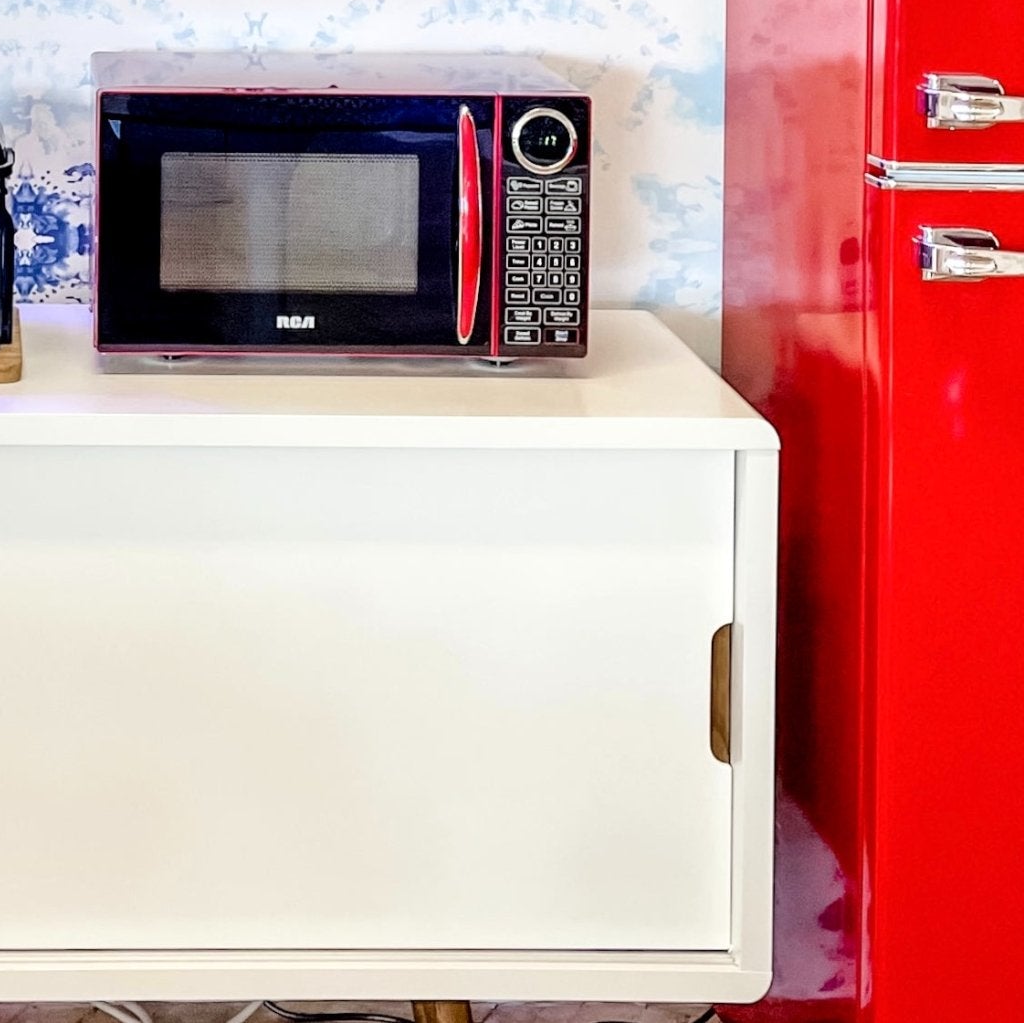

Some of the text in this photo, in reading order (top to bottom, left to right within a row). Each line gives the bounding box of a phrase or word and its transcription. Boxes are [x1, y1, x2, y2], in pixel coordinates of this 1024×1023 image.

[553, 241, 559, 250] 2
[569, 241, 576, 250] 3
[536, 258, 542, 266] 4
[536, 275, 542, 283] 7
[569, 275, 575, 284] 9
[569, 292, 575, 301] 0
[276, 315, 315, 329] RCA
